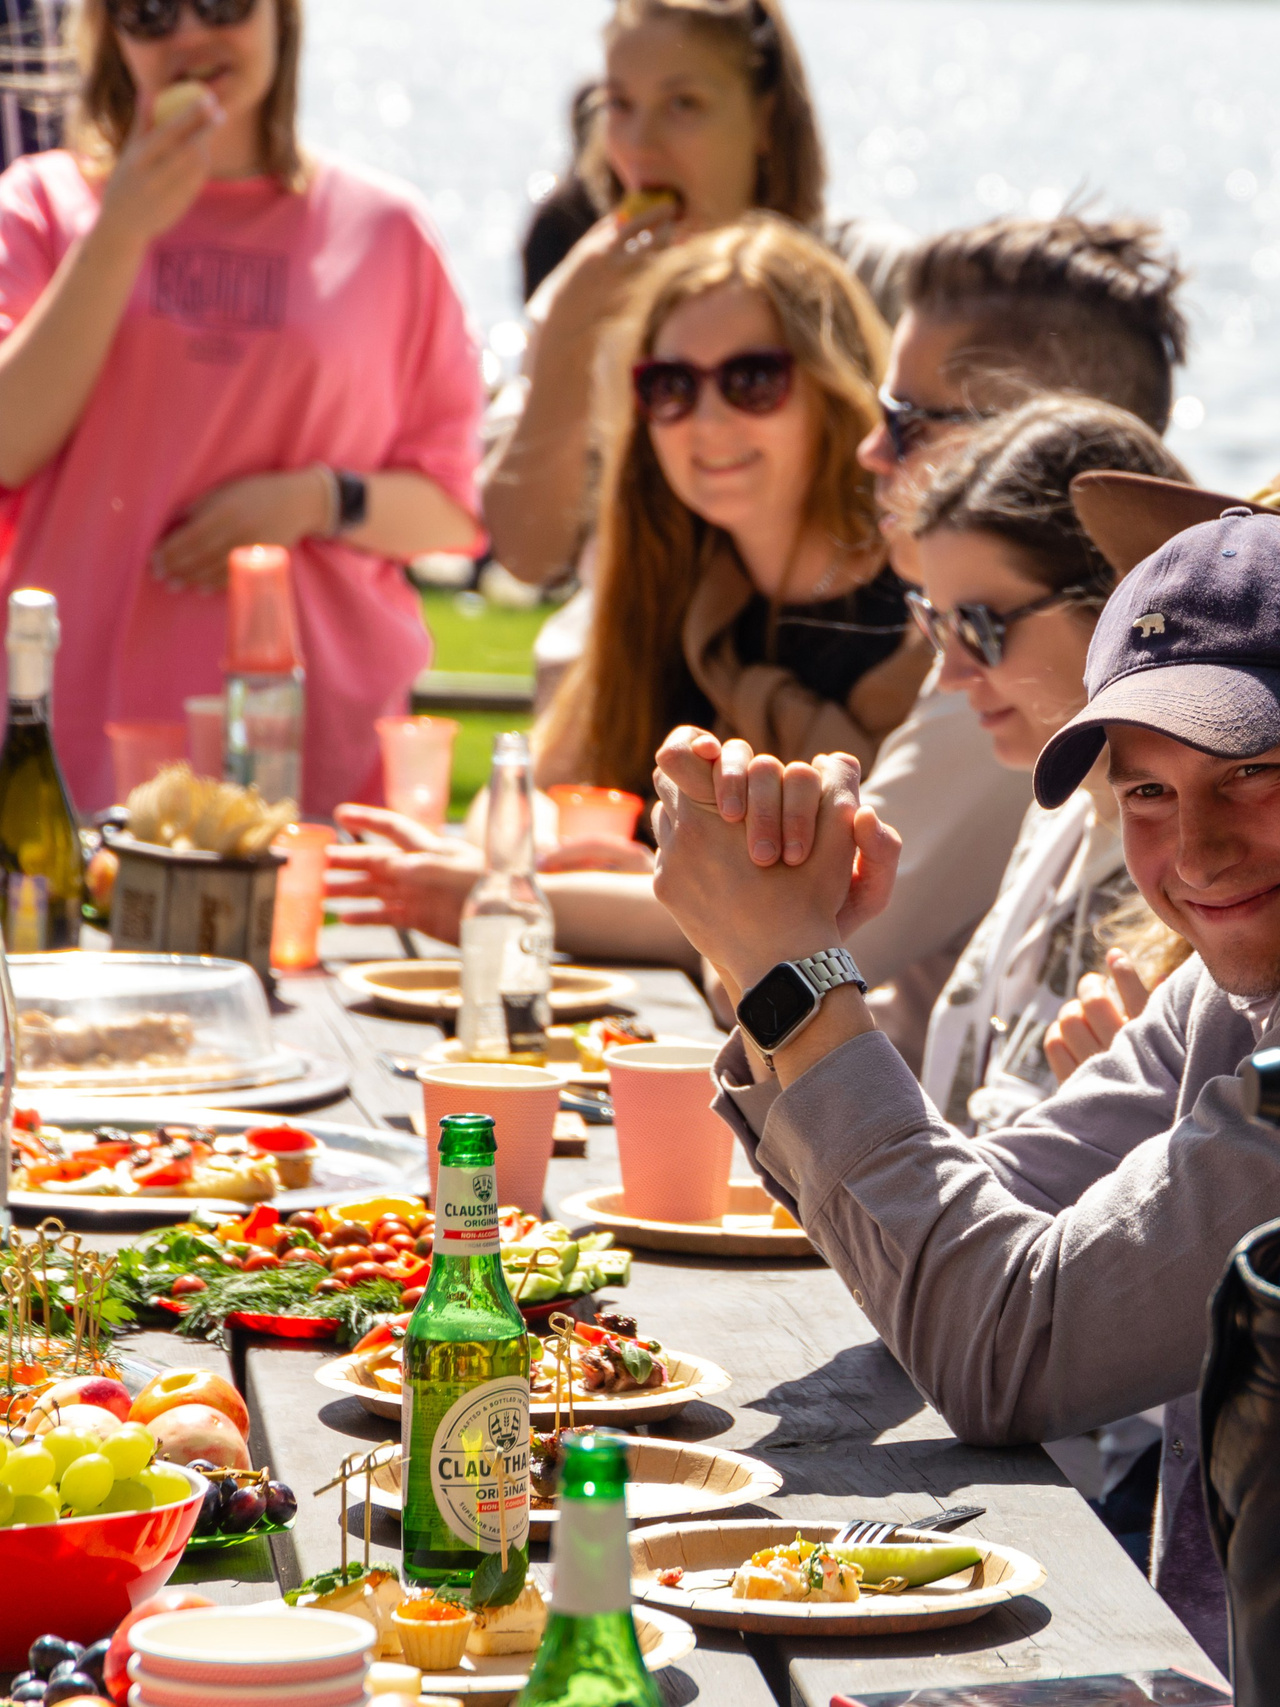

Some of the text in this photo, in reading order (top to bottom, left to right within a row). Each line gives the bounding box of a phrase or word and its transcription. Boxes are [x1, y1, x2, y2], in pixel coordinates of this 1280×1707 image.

[457, 1410, 481, 1438] CRAFTED
[489, 1396, 516, 1408] BOTTLED
[438, 1450, 528, 1480] CLAUTHA
[459, 1501, 487, 1530] SUPERIOR
